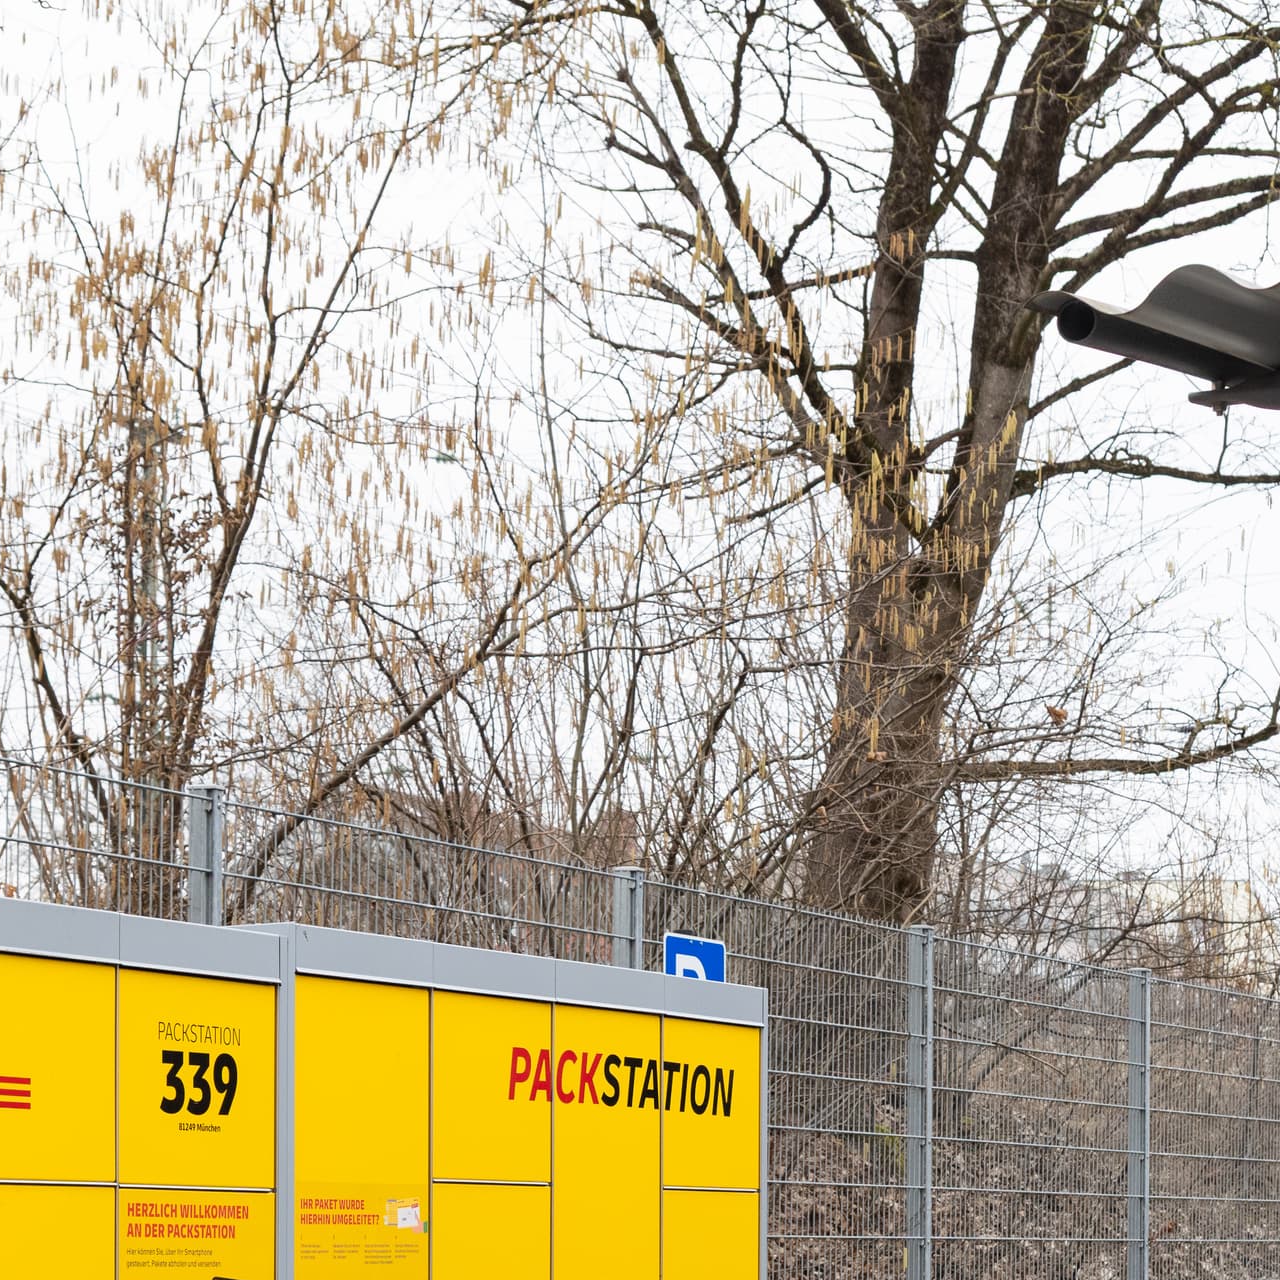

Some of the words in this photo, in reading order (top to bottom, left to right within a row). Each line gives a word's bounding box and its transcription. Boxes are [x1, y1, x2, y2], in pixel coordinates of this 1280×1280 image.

[158, 1021, 241, 1047] PACKSTATION
[159, 1049, 238, 1116] 339
[507, 1046, 735, 1117] PACKSTATION
[196, 1122, 221, 1133] München
[127, 1203, 177, 1218] HERZLICH
[180, 1204, 249, 1220] WILLKOMMEN
[300, 1198, 313, 1209] IHR
[314, 1199, 338, 1210] PAKET
[338, 1199, 365, 1210] WURDE
[300, 1214, 331, 1225] HIERHIN
[332, 1214, 380, 1225] UMGELEITET?
[127, 1223, 142, 1238] AN
[144, 1223, 165, 1238] DER
[167, 1224, 236, 1239] PACKSTATION
